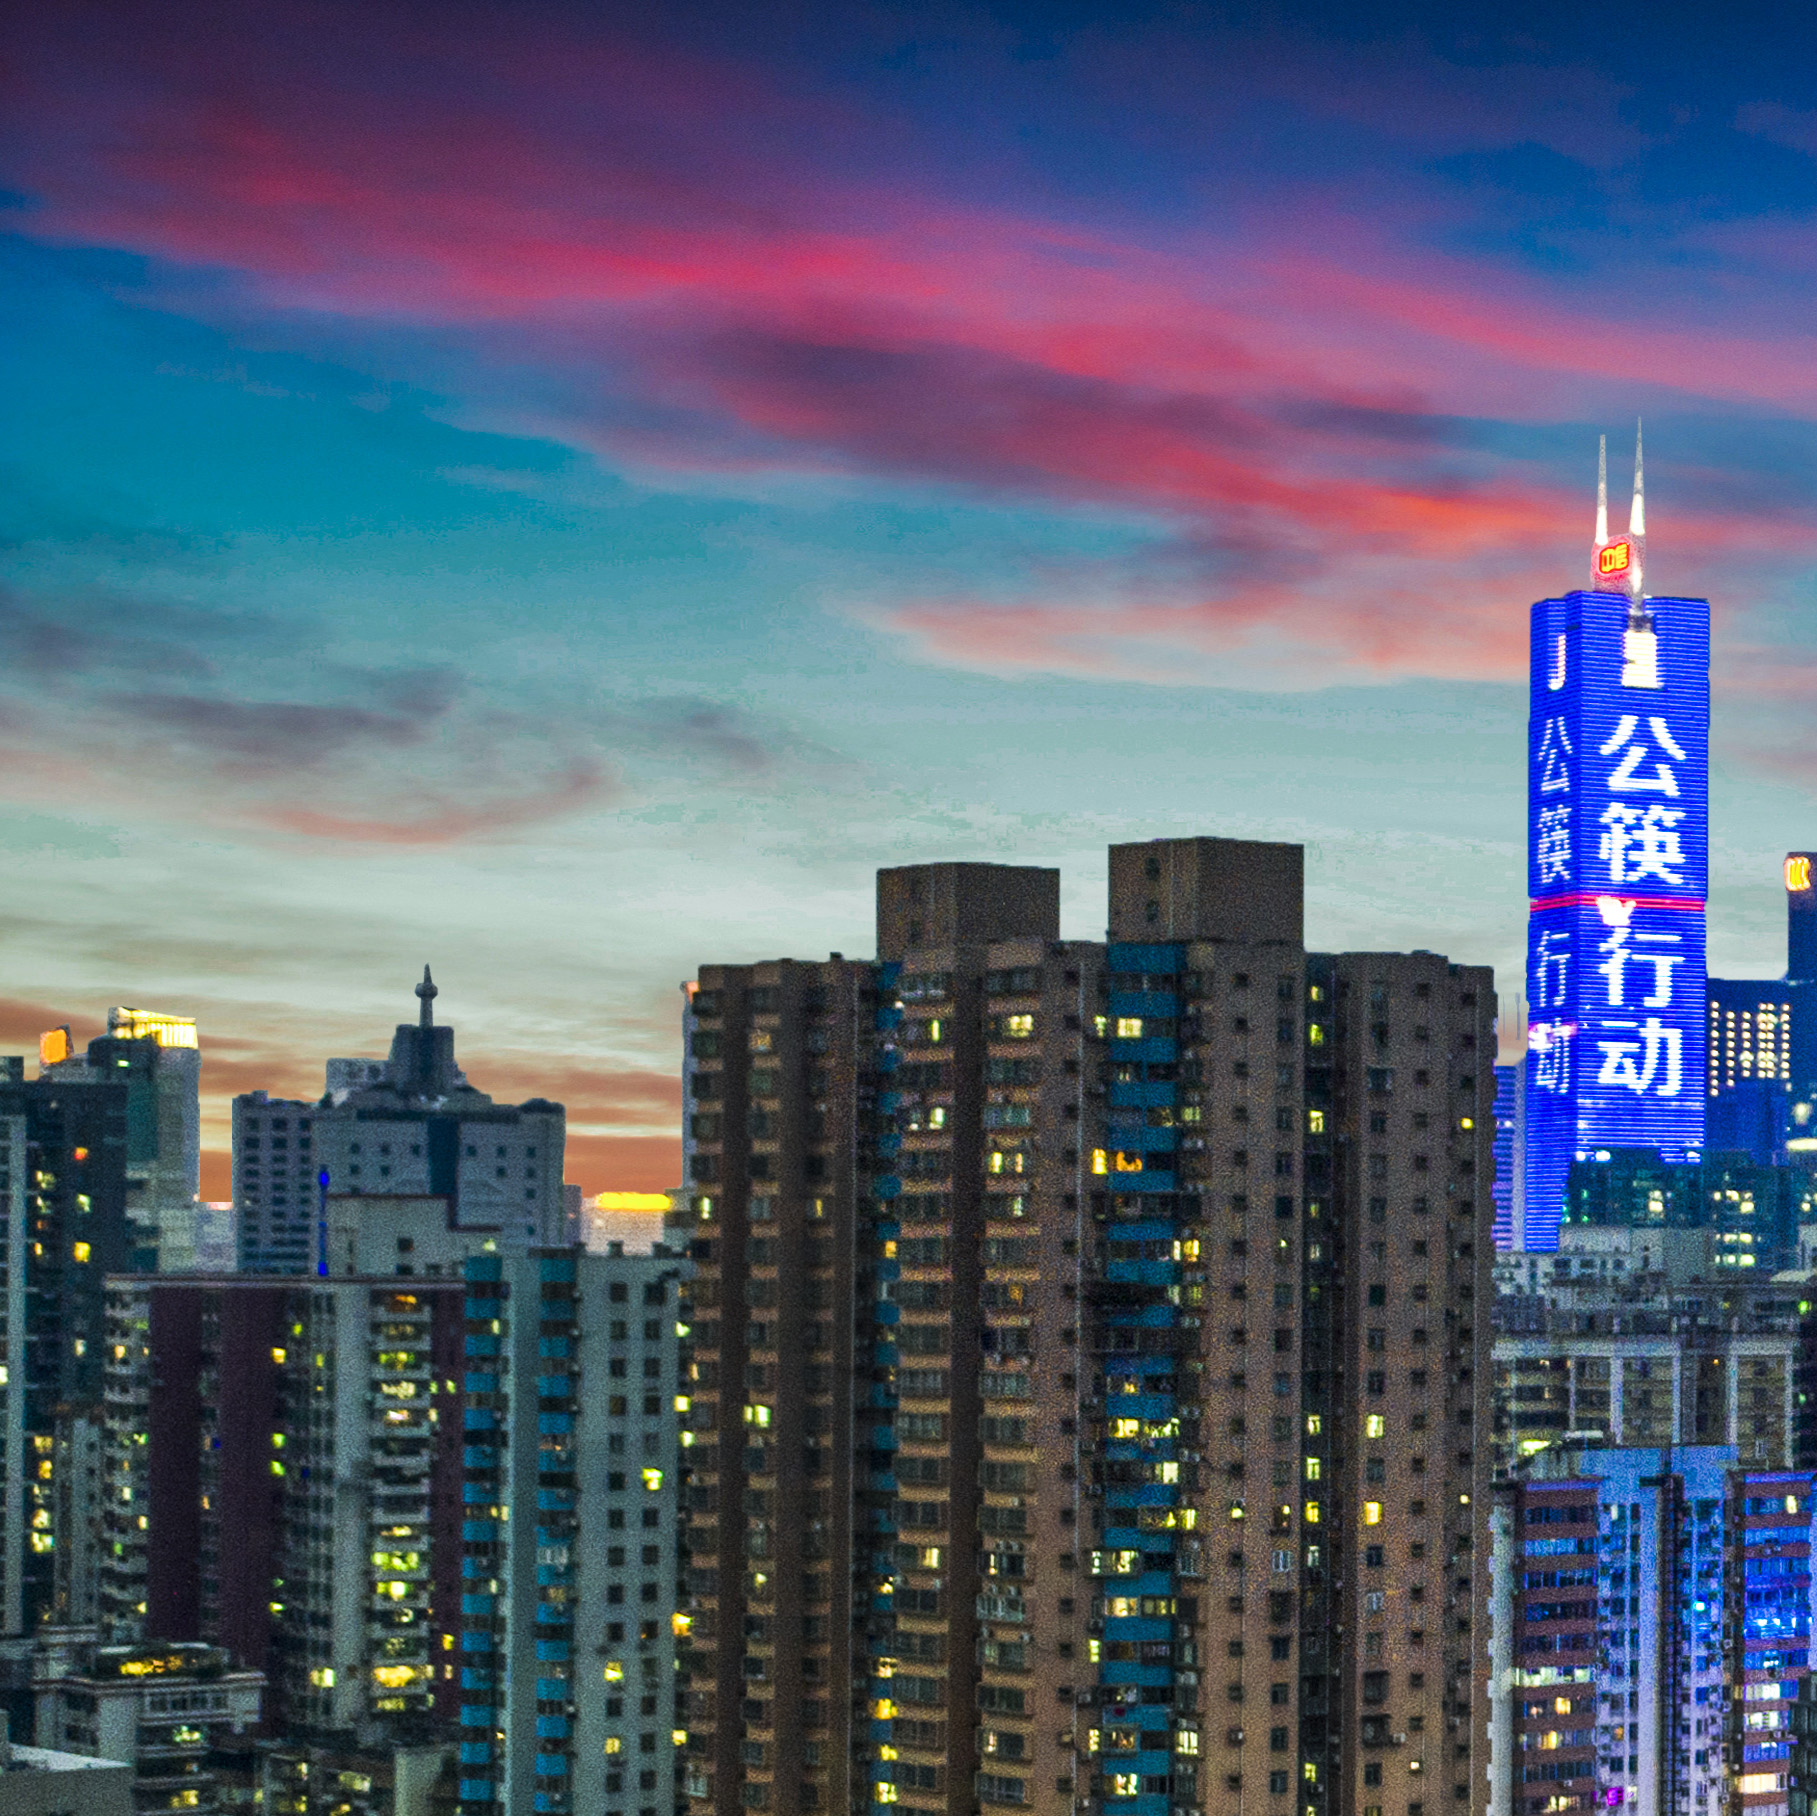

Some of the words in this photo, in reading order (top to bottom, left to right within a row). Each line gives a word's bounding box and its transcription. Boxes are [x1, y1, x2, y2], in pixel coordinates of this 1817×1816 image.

[1535, 715, 1573, 1096] 公筷行动
[1598, 714, 1687, 1097] 公筷行动
